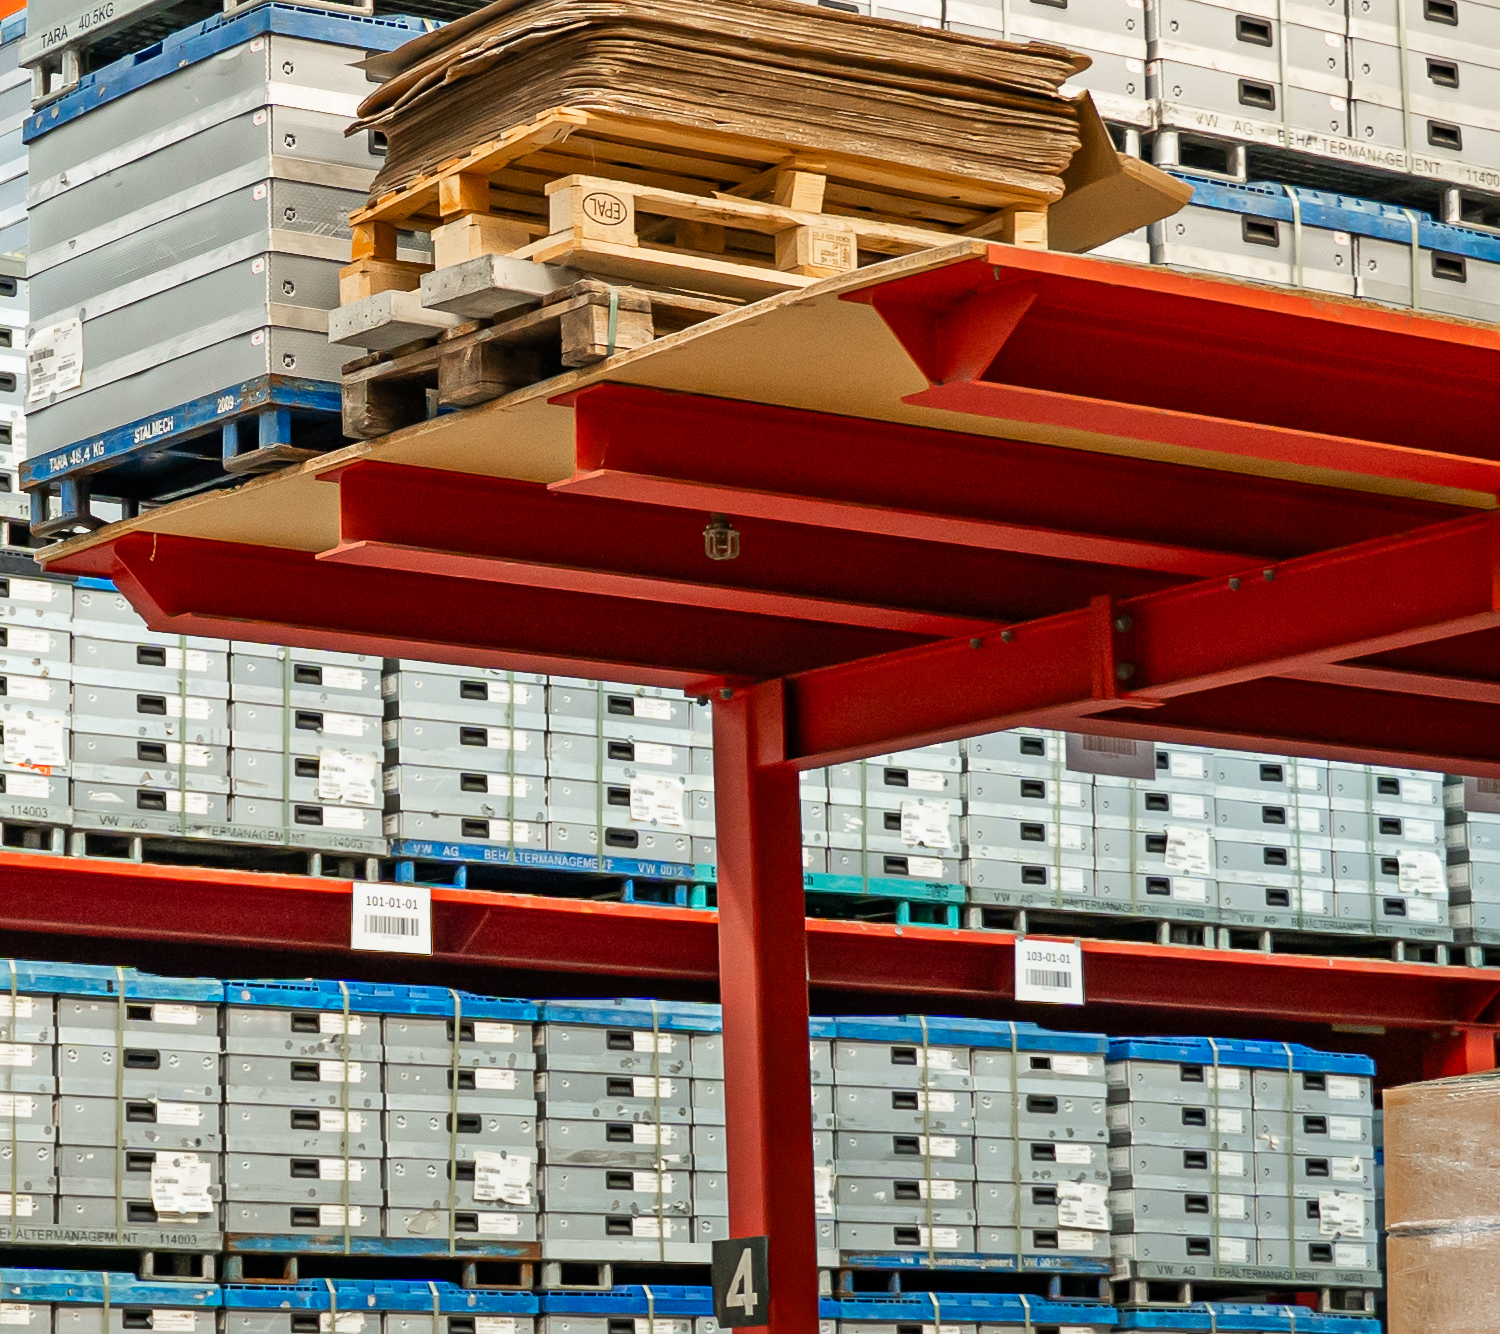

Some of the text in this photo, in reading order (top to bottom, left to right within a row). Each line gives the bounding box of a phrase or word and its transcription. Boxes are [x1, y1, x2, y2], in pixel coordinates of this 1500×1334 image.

[41, 24, 68, 49] TARA
[79, 2, 113, 30] 40.5KG
[1197, 113, 1218, 128] VW
[1234, 121, 1253, 135] AG
[589, 197, 620, 219] EPAL
[92, 440, 105, 458] KG
[134, 416, 174, 444] STALMECH
[10, 805, 48, 819] 114003
[413, 844, 432, 855] VW
[443, 846, 458, 857] AG
[638, 863, 656, 874] VW
[366, 895, 418, 910] 101-01-01
[1026, 951, 1071, 964] 103-01-01
[159, 1233, 198, 1245] 114003
[1157, 1264, 1174, 1275] VW
[1182, 1266, 1196, 1277] AG
[725, 1247, 758, 1317] 4
